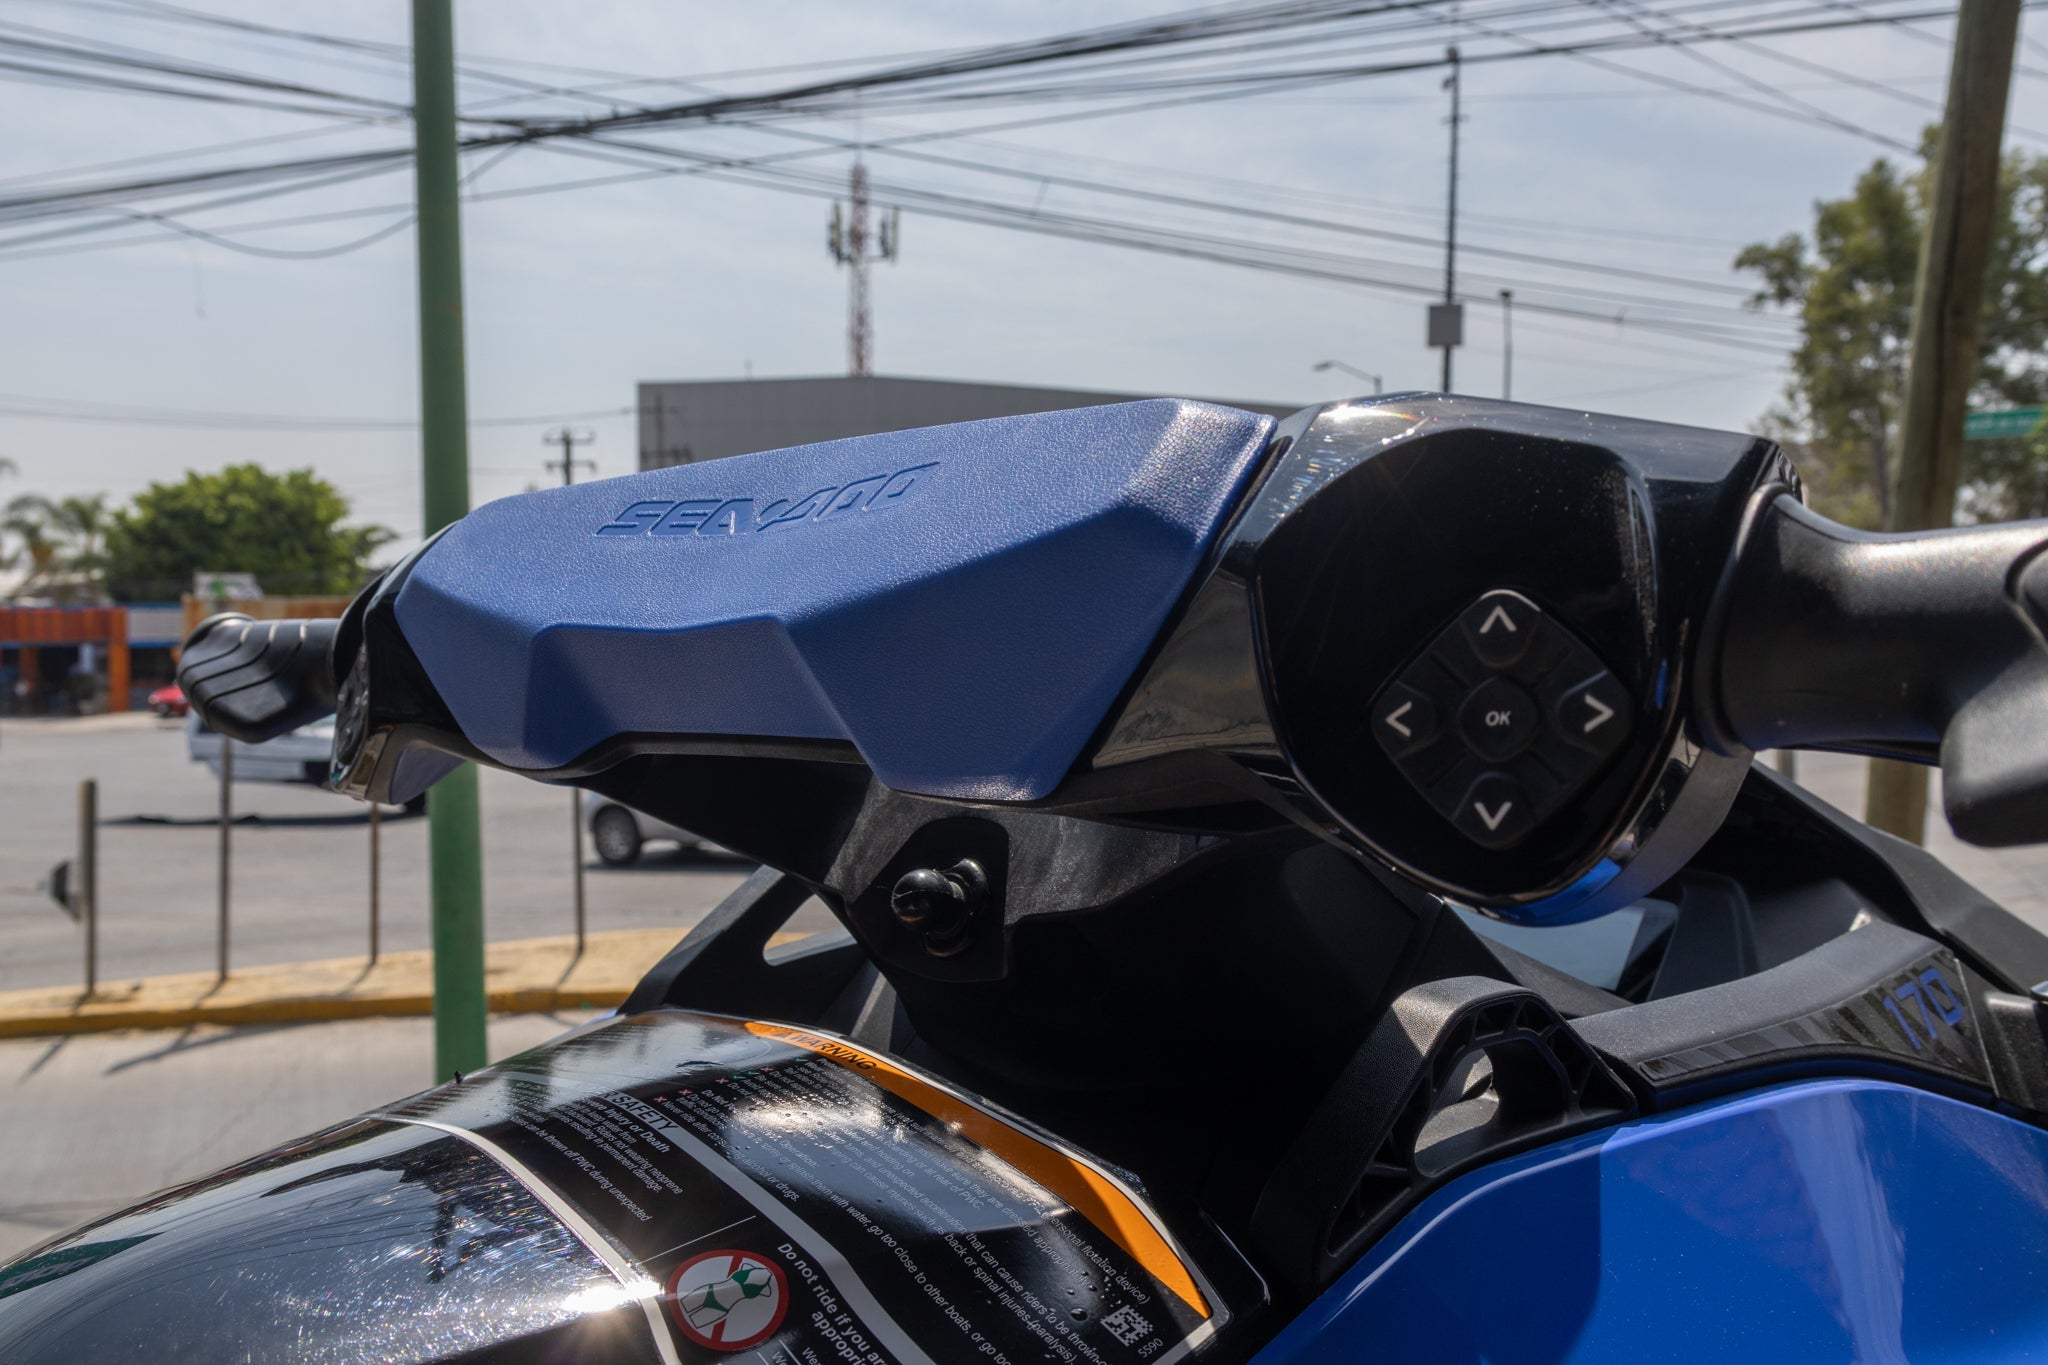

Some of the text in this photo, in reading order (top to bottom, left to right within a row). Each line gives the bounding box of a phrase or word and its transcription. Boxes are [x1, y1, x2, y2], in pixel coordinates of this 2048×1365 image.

[1485, 710, 1511, 727] OK
[1883, 968, 1964, 1050] 170
[604, 1108, 633, 1124] Injury
[629, 1124, 644, 1133] or
[640, 1131, 670, 1153] Death
[612, 1096, 679, 1130] SAFETY
[619, 1132, 637, 1143] from
[544, 1134, 568, 1151] thrown
[564, 1150, 580, 1158] off
[573, 1156, 595, 1172] PWC
[589, 1170, 613, 1190] during
[609, 1187, 653, 1222] unexpected
[599, 1142, 638, 1169] permanent
[633, 1168, 662, 1193] damage.
[614, 1140, 630, 1150] not
[624, 1148, 653, 1170] wearing
[648, 1167, 683, 1194] neoprene
[662, 1101, 684, 1117] Never
[680, 1114, 696, 1124] ride
[692, 1122, 712, 1133] after
[767, 1174, 780, 1183] or
[775, 1182, 800, 1202] drugs.
[915, 1159, 928, 1168] or
[934, 1174, 953, 1187] rear
[950, 1183, 964, 1195] of
[950, 1170, 972, 1186] sure
[969, 1183, 991, 1199] they
[987, 1196, 1005, 1209] are
[1002, 1207, 1039, 1237] dressed
[814, 1180, 833, 1196] them
[830, 1194, 849, 1209] with
[846, 1206, 872, 1227] water,
[867, 1225, 884, 1236] go
[881, 1233, 897, 1248] too
[894, 1247, 918, 1273] close
[914, 1272, 927, 1284] to
[923, 1283, 949, 1307] other
[944, 1306, 972, 1334] boats,
[971, 1332, 985, 1344] or
[978, 1341, 996, 1356] go
[879, 1166, 926, 1200] unexpected
[920, 1197, 969, 1234] acceleration
[965, 1232, 986, 1252] that
[980, 1251, 1000, 1268] can
[996, 1267, 1024, 1293] cause
[1020, 1290, 1048, 1315] riders
[1045, 1311, 1058, 1324] to
[1054, 1320, 1070, 1334] be
[914, 1210, 936, 1226] such
[933, 1225, 947, 1236] as
[944, 1233, 967, 1257] back
[964, 1256, 978, 1268] or
[973, 1266, 1002, 1294] spinal
[997, 1290, 1032, 1324] injuries
[1082, 1245, 1117, 1276] flotation
[1115, 1274, 1151, 1304] device)
[777, 1243, 887, 1365] Do not ride if you ar
[1138, 1338, 1163, 1358] 5590
